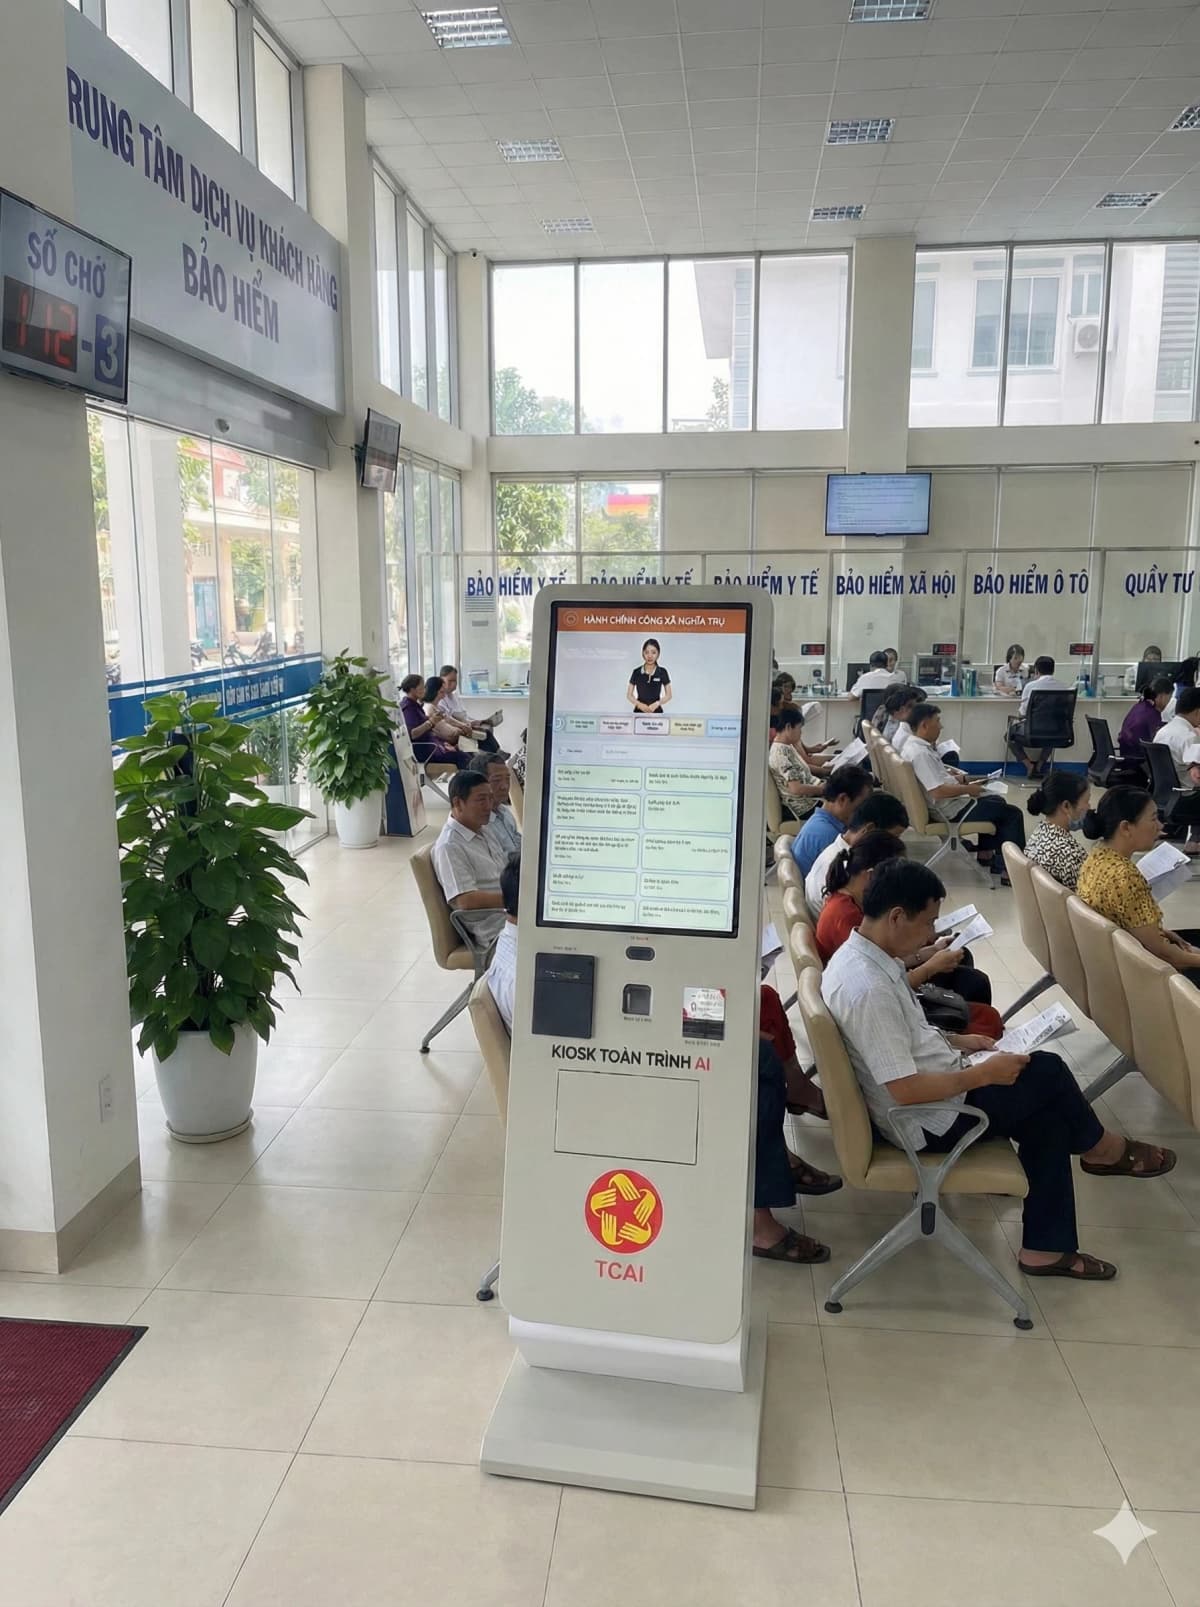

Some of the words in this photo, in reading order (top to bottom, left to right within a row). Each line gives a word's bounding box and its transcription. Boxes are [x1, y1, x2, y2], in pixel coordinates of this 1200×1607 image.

[66, 66, 134, 167] RUNG
[139, 124, 185, 203] TÂM
[190, 163, 232, 237] DỊCH
[235, 199, 256, 262] VỤ
[259, 220, 304, 288] KHÁCH
[307, 254, 338, 312] HÀNG
[182, 239, 226, 313] BẢO
[233, 269, 280, 343] HIỂM
[467, 569, 494, 596] BẢO
[499, 566, 533, 596] HIỂM
[787, 575, 797, 595] Y
[801, 567, 820, 595] TẾ
[836, 567, 864, 596] BẢO
[868, 565, 904, 596] HIỂM
[909, 570, 927, 595] XÃ
[931, 569, 956, 599] HỘI
[973, 566, 1005, 595] BẢO
[1009, 563, 1048, 595] HIỂM
[1053, 569, 1064, 595] Ô
[1069, 568, 1089, 595] TÔ
[1125, 563, 1169, 597] QUẦY
[1172, 570, 1195, 594] TƯ
[583, 613, 608, 625] HÀNH
[609, 614, 637, 625] CHÍNH
[638, 614, 663, 626] CÔNG
[664, 615, 677, 625] XÃ
[678, 615, 706, 627] NGHĨA
[707, 616, 726, 628] TRỤ
[551, 1044, 597, 1062] KIOSK
[599, 1046, 642, 1066] TOÀN
[645, 1047, 691, 1069] TRÌNH
[694, 1056, 711, 1072] AI
[594, 1259, 645, 1283] TCAI
